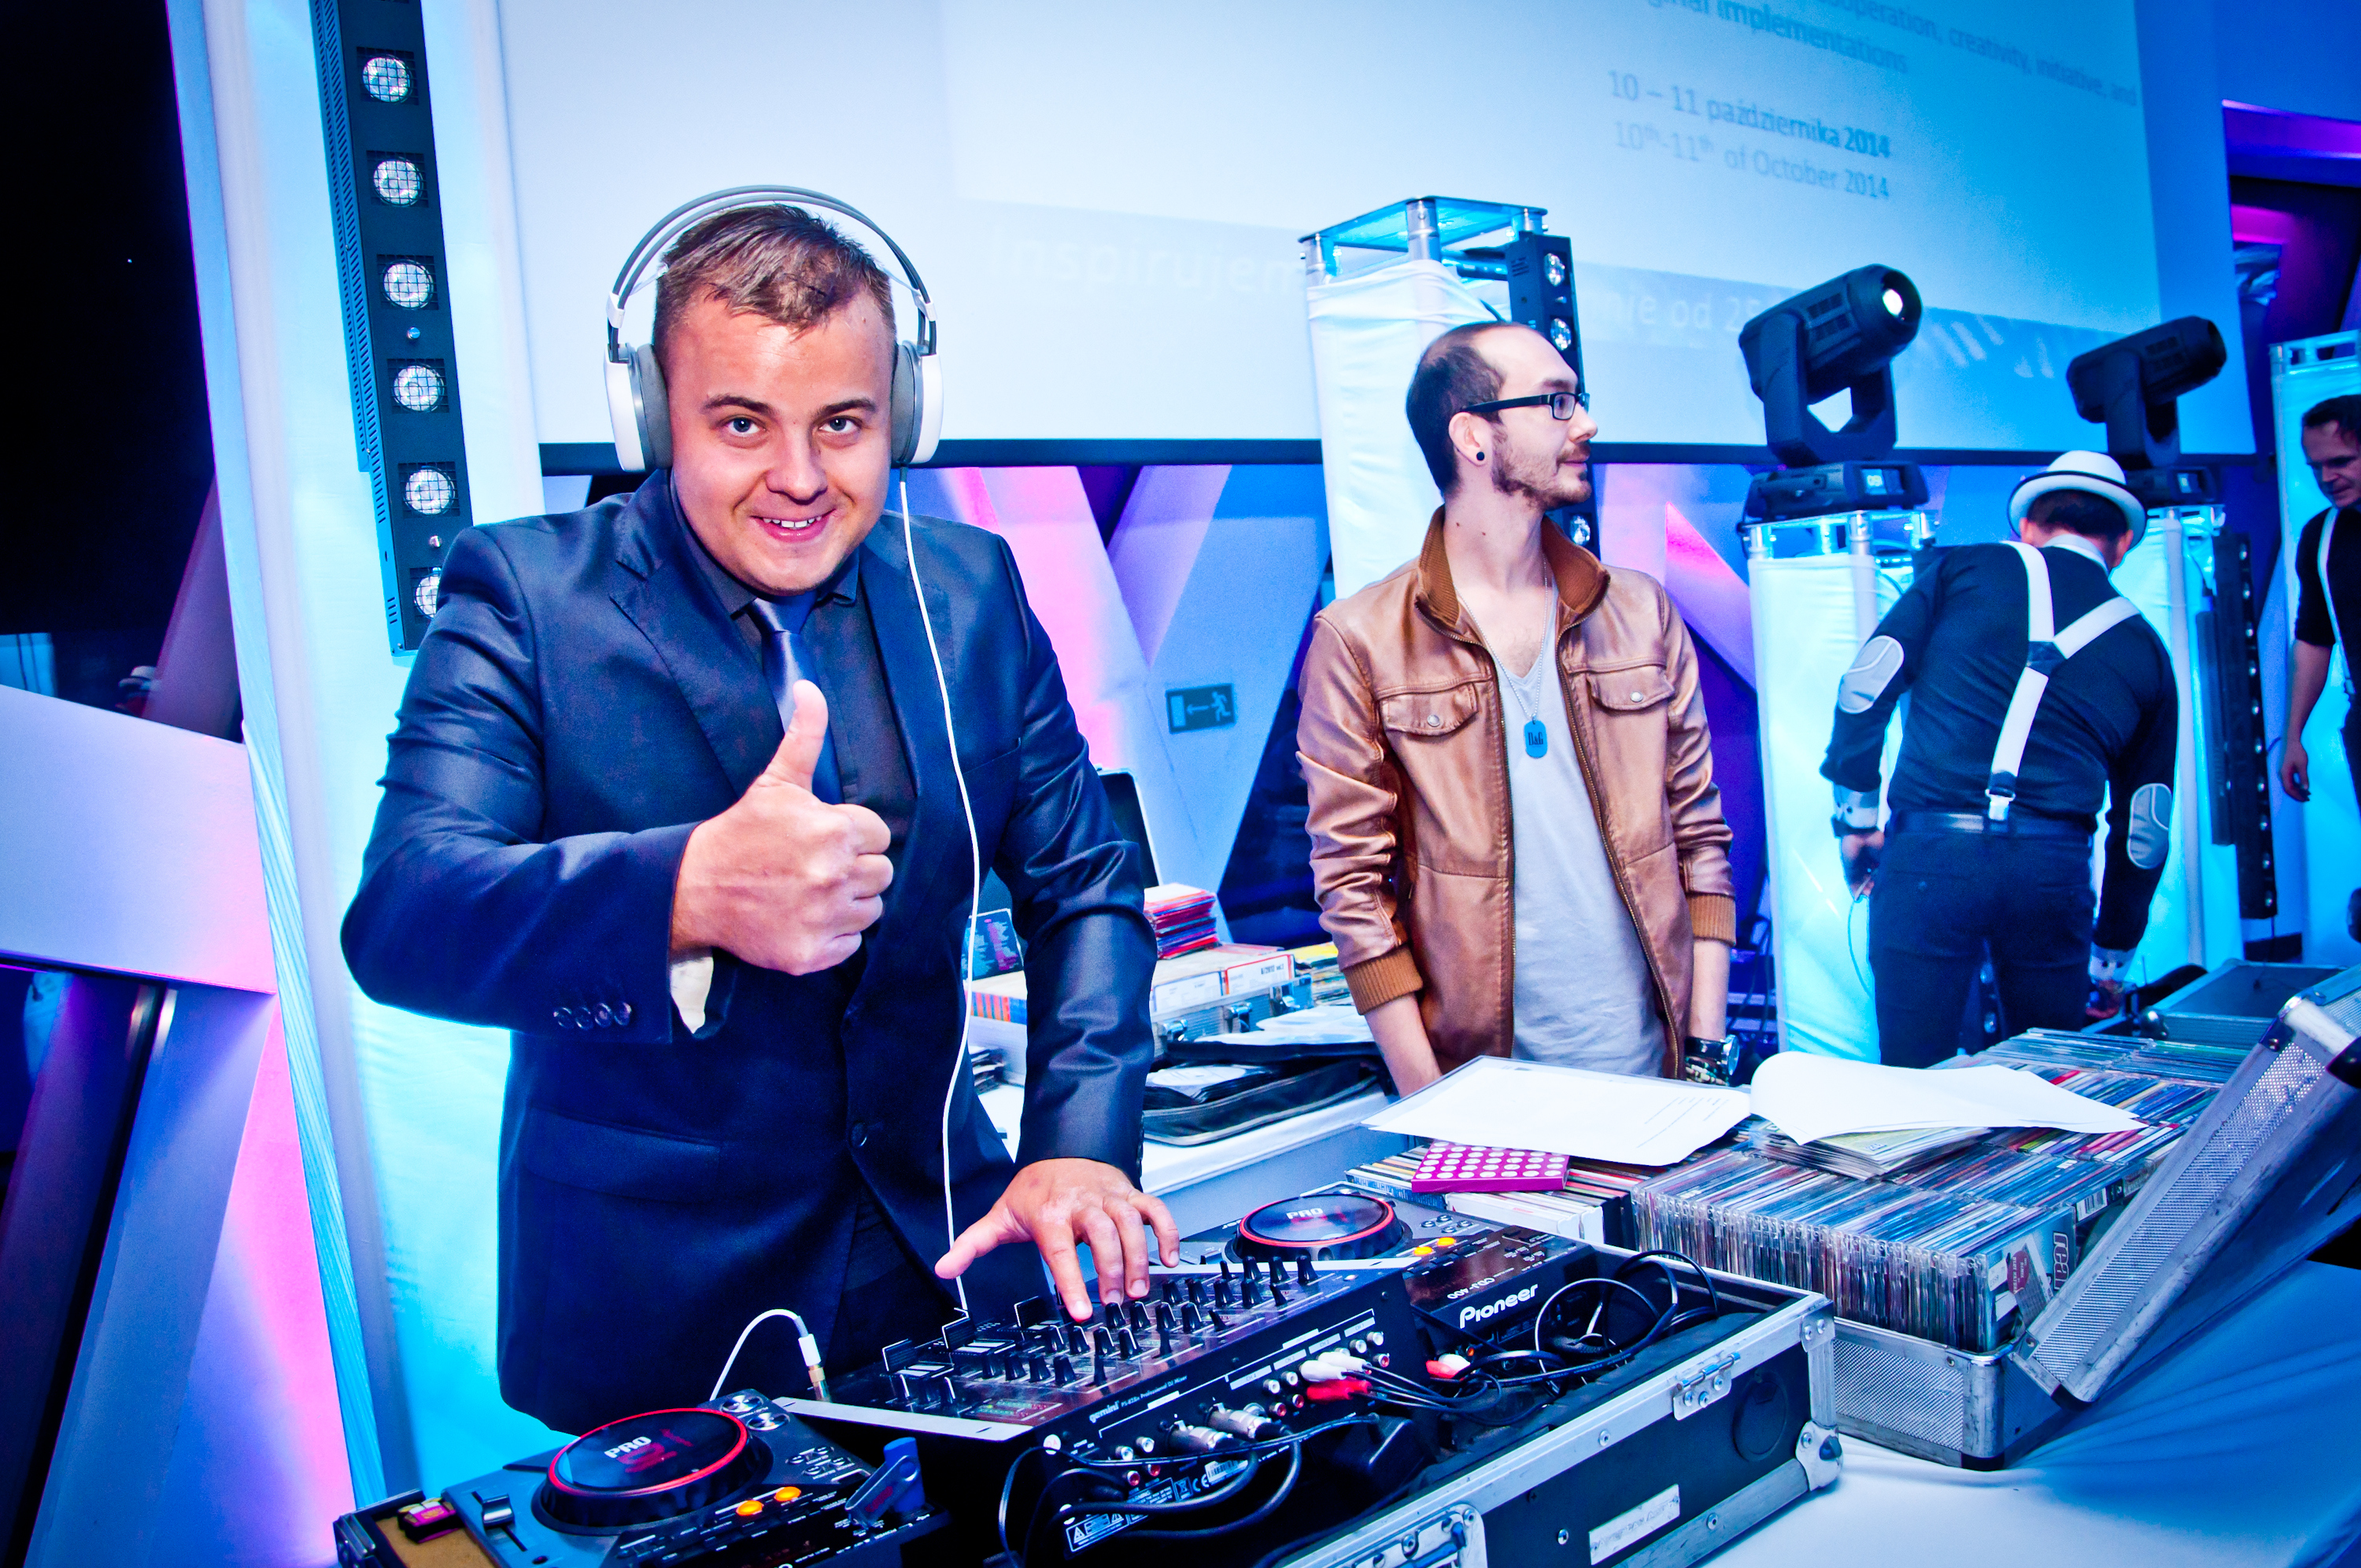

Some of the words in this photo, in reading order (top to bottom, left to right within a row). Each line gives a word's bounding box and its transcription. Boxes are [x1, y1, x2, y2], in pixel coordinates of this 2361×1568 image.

[1716, 0, 1908, 74] implementations
[1816, 0, 1942, 46] operation,
[1948, 27, 2032, 76] creativity,
[2111, 83, 2137, 107] and
[1608, 71, 1639, 101] 10
[1671, 85, 1701, 116] 11
[1706, 98, 1841, 148] października
[1843, 126, 1891, 160] 2014
[1724, 146, 1747, 171] of
[1753, 149, 1838, 190] October
[1843, 168, 1890, 200] 2014
[1528, 732, 1544, 746] D&G
[1286, 1208, 1324, 1219] PRO
[1447, 1277, 1495, 1300] CDJ-400
[1460, 1284, 1539, 1330] Pioneer
[1088, 1402, 1119, 1423] gemini
[604, 1436, 652, 1459] PRO
